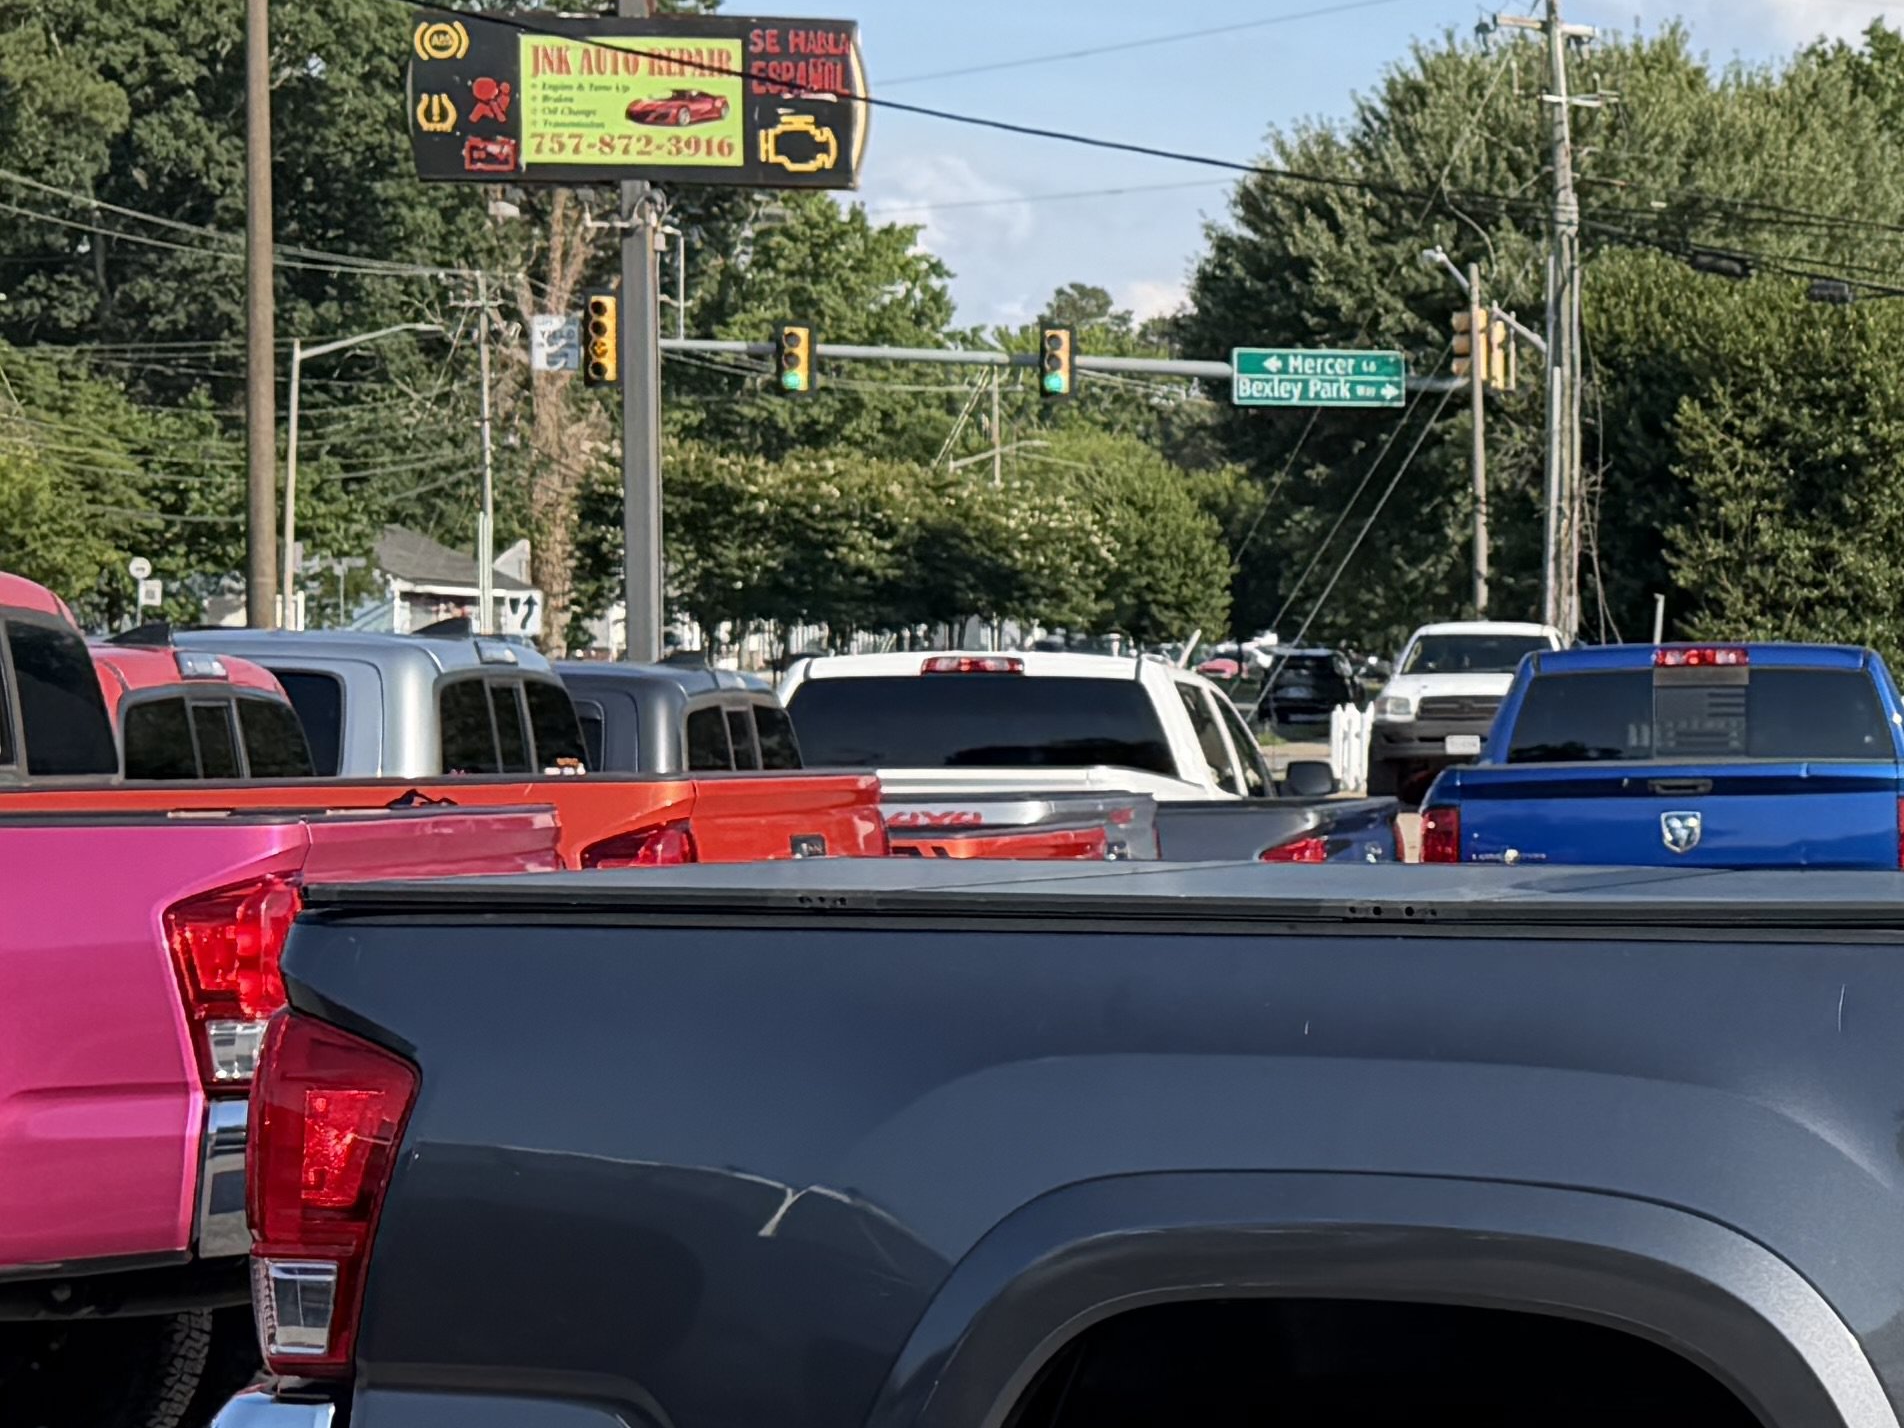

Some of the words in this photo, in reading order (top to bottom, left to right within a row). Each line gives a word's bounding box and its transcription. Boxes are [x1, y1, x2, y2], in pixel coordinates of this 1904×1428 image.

[749, 28, 781, 54] SE
[788, 29, 850, 55] HABLA
[531, 45, 572, 77] JNK
[580, 45, 641, 77] AUTO
[648, 48, 733, 79] REPAIR
[530, 132, 735, 158] 757-872-3916
[1288, 355, 1355, 374] Mercer
[1238, 378, 1303, 403] Bexley
[1308, 379, 1351, 399] Park
